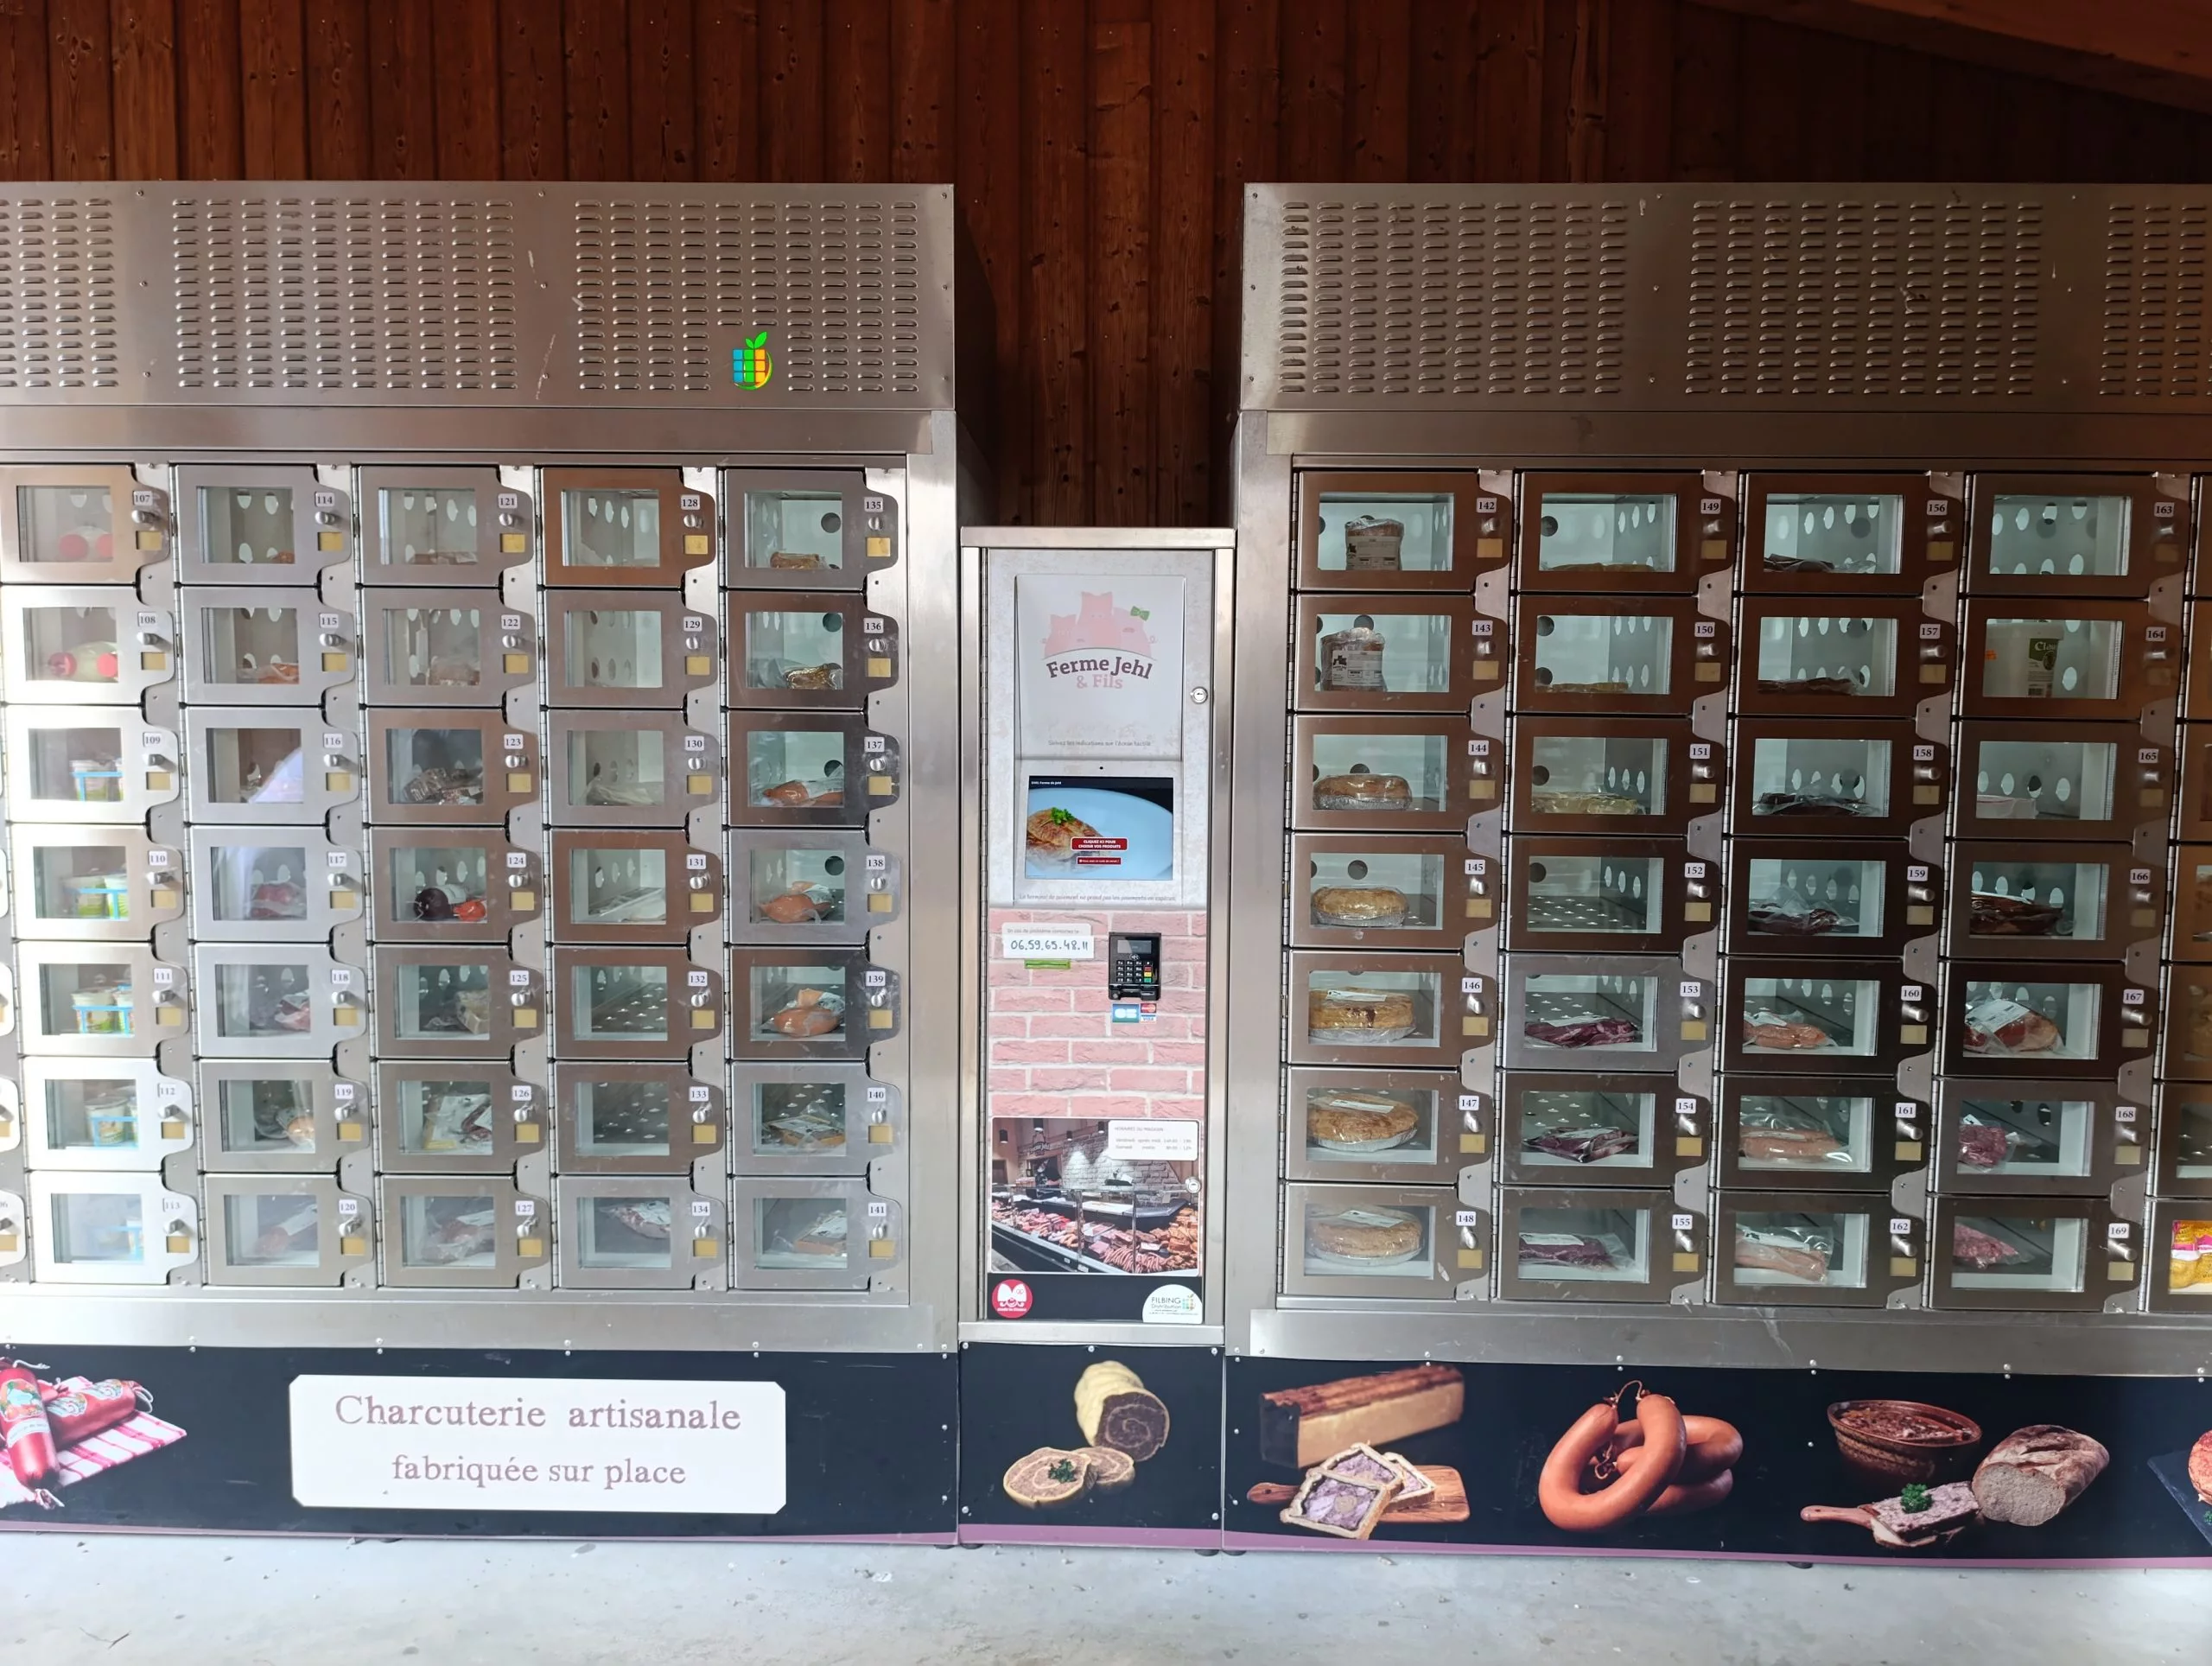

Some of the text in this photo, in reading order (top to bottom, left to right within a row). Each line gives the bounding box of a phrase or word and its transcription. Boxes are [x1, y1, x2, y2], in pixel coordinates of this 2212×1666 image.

[135, 494, 150, 503] 107
[317, 495, 333, 505] 114
[500, 497, 515, 506] 121
[683, 499, 698, 507] 128
[866, 500, 881, 510] 135
[1478, 501, 1495, 510] 142
[1702, 502, 1719, 512] 149
[1929, 504, 1946, 512] 156
[2156, 506, 2173, 514] 163
[140, 615, 156, 624] 108
[321, 617, 338, 626] 115
[503, 618, 518, 627] 122
[684, 620, 701, 629] 129
[866, 622, 881, 631] 136
[1475, 624, 1491, 633] 143
[1697, 626, 1713, 634] 150
[1922, 627, 1939, 636] 157
[2148, 630, 2164, 639] 164
[1046, 657, 1153, 679] Ferme Jehl
[1076, 673, 1123, 690] & Fils
[145, 736, 162, 745] 109
[325, 737, 341, 746] 116
[505, 738, 522, 747] 123
[687, 740, 702, 748] 130
[868, 741, 883, 749] 137
[1471, 744, 1487, 753] 144
[1693, 747, 1708, 756] 151
[1916, 748, 1932, 758] 158
[2140, 752, 2158, 761] 165
[150, 855, 166, 863] 110
[329, 855, 345, 864] 117
[509, 856, 524, 865] 124
[690, 858, 703, 867] 131
[868, 859, 884, 868] 138
[1468, 863, 1484, 872] 145
[1687, 866, 1703, 874] 152
[1910, 869, 1926, 878] 159
[2132, 872, 2149, 881] 166
[156, 972, 170, 981] 111
[334, 973, 349, 982] 118
[512, 974, 527, 982] 125
[690, 975, 706, 983] 132
[868, 975, 884, 983] 139
[1465, 981, 1480, 989] 146
[1682, 985, 1699, 994] 153
[2126, 992, 2142, 1002] 167
[160, 1087, 175, 1096] 112
[336, 1088, 353, 1097] 119
[869, 1091, 885, 1099] 140
[1462, 1098, 1478, 1107] 147
[1678, 1102, 1694, 1110] 154
[1898, 1106, 1913, 1115] 161
[2118, 1110, 2134, 1119] 168
[340, 1203, 356, 1211] 120
[518, 1204, 532, 1212] 127
[693, 1205, 709, 1213] 134
[870, 1205, 885, 1214] 141
[1459, 1214, 1474, 1223] 148
[1675, 1218, 1691, 1226] 155
[1892, 1222, 1909, 1231] 162
[2111, 1226, 2127, 1235] 169
[335, 1395, 741, 1431] Charcuterie artisanale
[391, 1453, 687, 1491] fabriquée sur place
